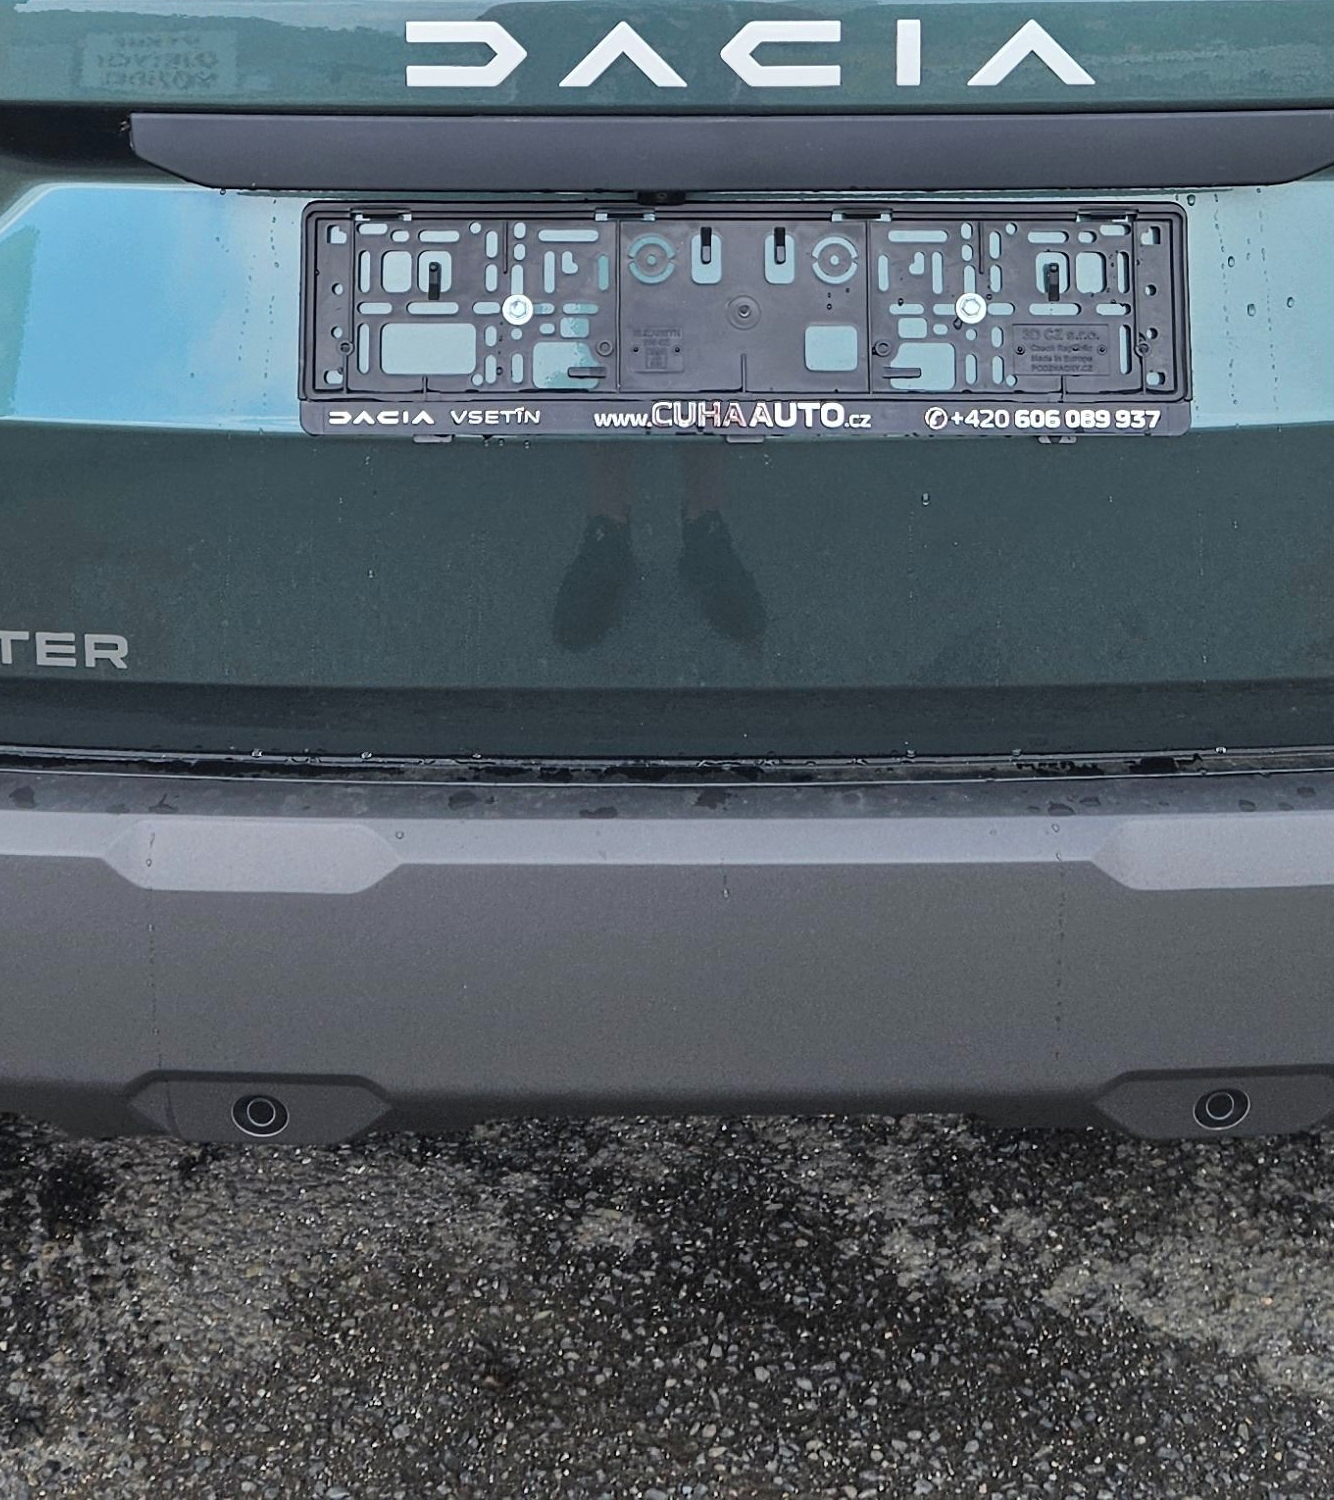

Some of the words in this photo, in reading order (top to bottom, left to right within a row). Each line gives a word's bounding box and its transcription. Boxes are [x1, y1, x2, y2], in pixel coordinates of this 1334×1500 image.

[406, 19, 1096, 88] DACIA
[328, 410, 434, 424] DACIA
[594, 401, 872, 428] www.CUHAAUTO.cz
[950, 409, 1010, 428] +420
[1014, 409, 1060, 428] 606
[1065, 410, 1110, 428] 089
[1115, 410, 1161, 428] 937
